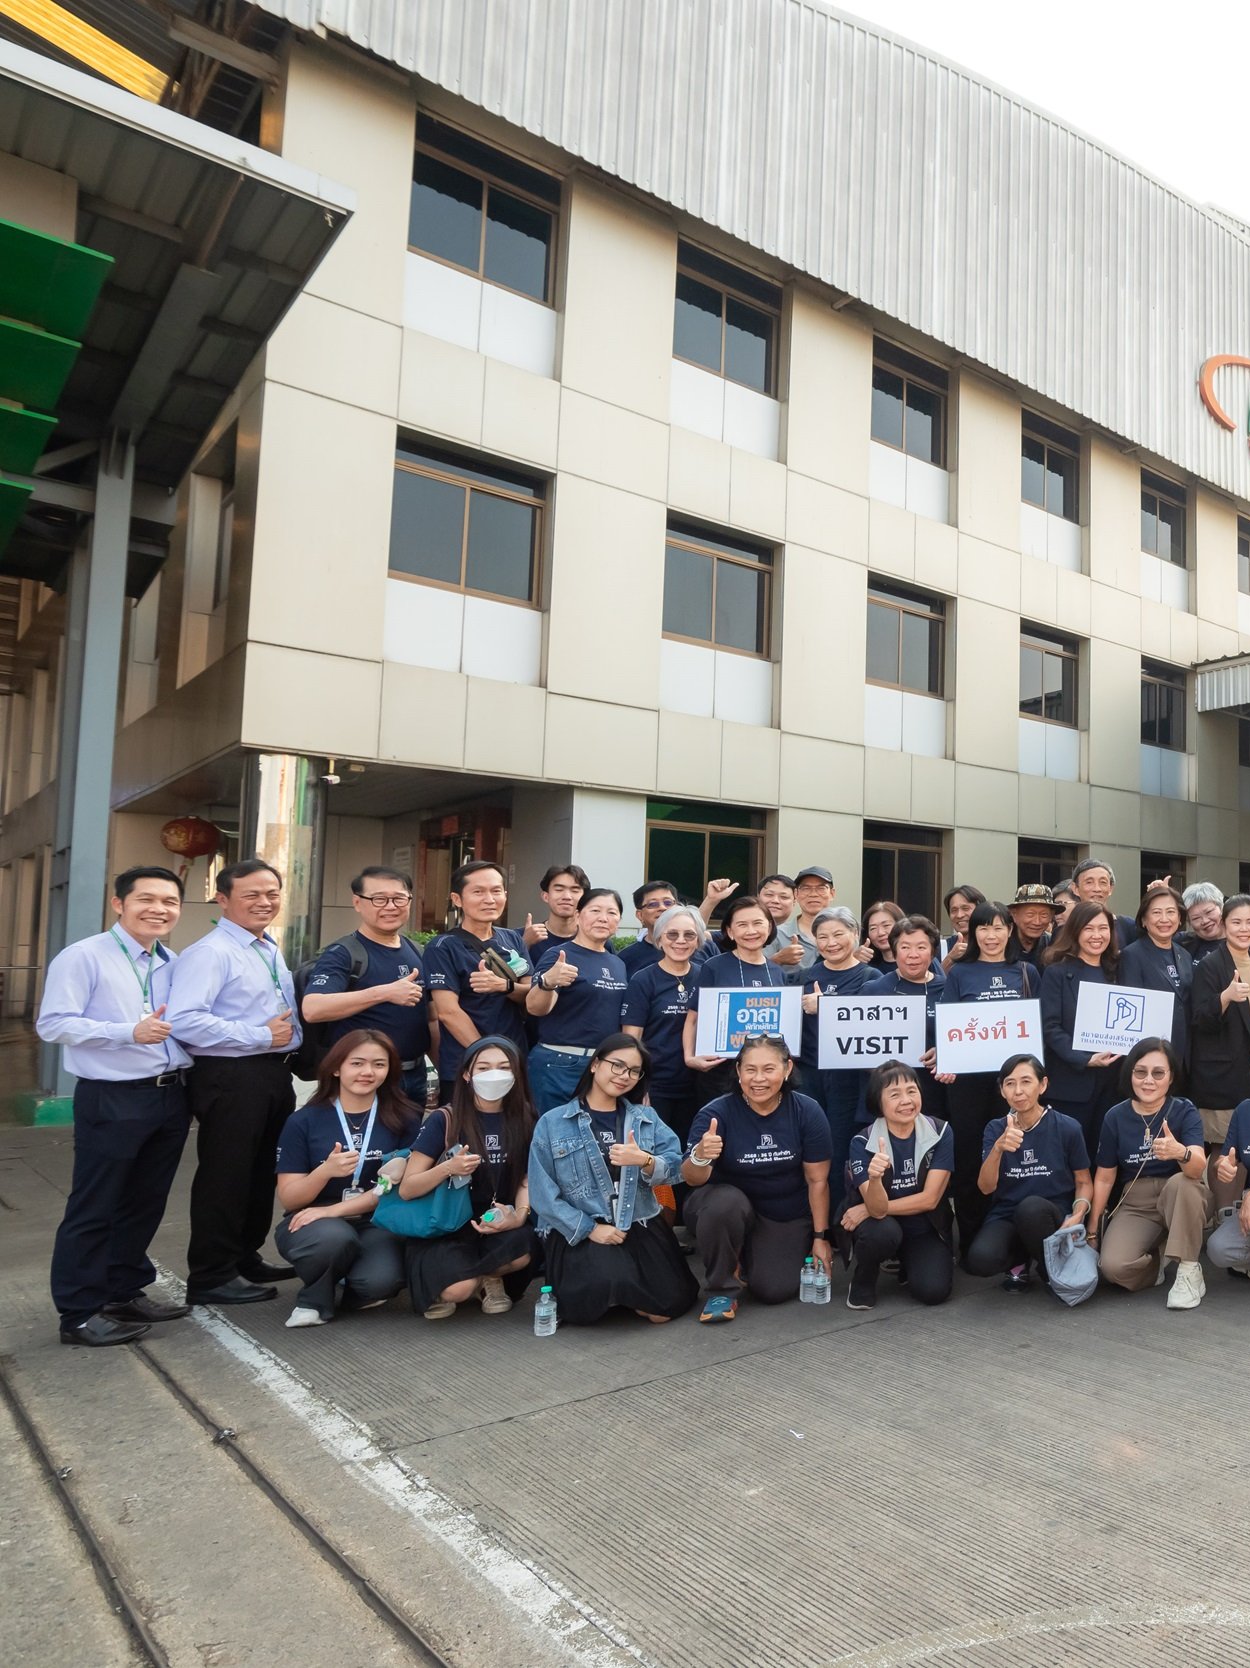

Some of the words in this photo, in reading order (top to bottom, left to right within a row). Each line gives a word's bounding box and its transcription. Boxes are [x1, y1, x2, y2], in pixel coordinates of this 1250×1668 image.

[745, 997, 779, 1008] ชมรม
[736, 1007, 778, 1024] อาสา
[837, 1004, 908, 1021] อาสาฯ
[947, 1015, 1007, 1042] ครั้งที่
[1016, 1020, 1030, 1039] 1
[835, 1035, 909, 1055] VISIT
